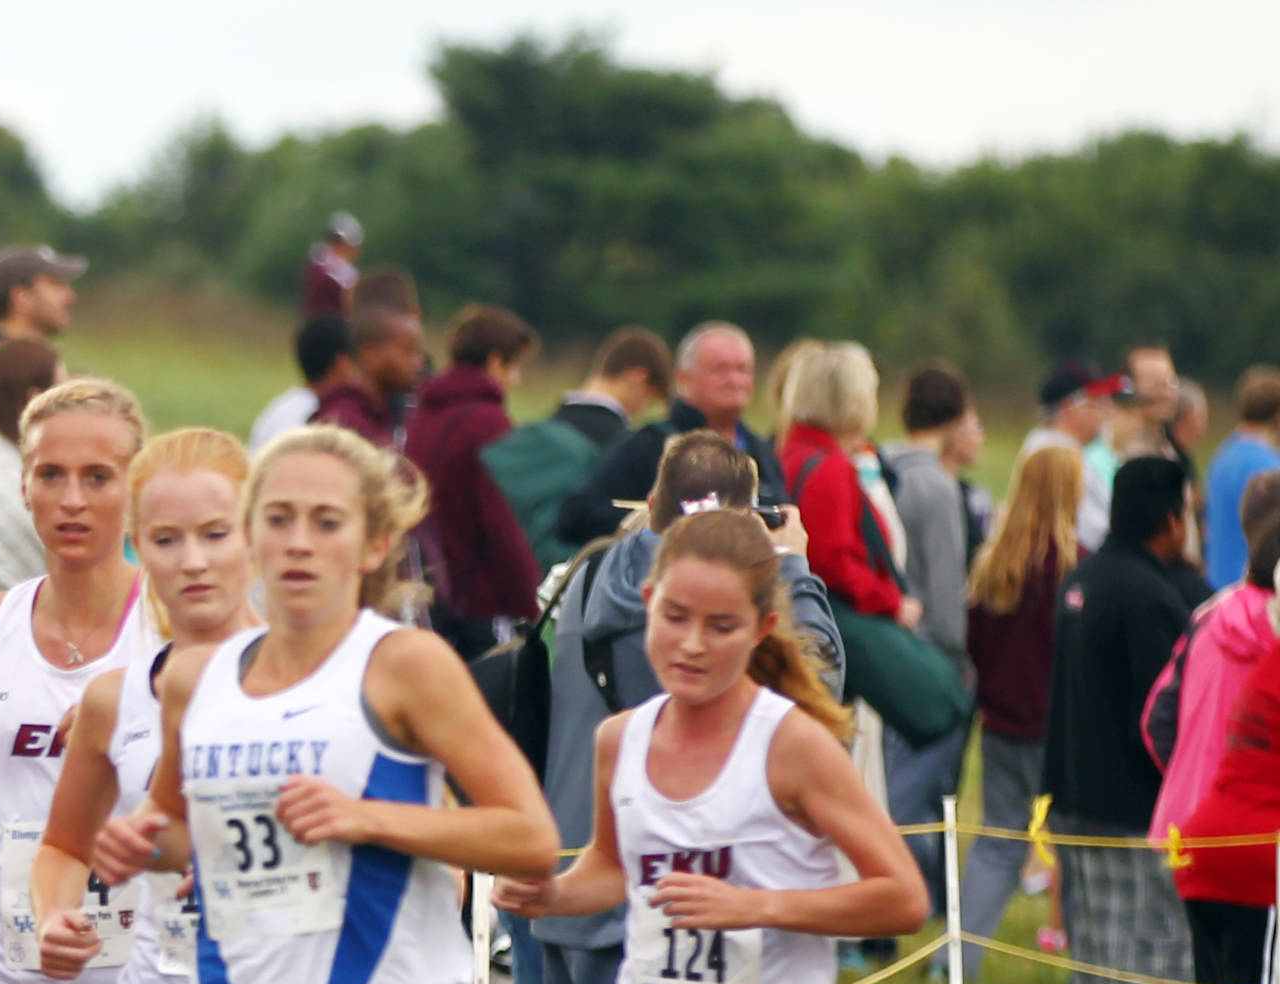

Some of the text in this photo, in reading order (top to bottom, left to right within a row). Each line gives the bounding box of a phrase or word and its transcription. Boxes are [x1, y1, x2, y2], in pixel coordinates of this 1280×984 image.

[184, 740, 328, 778] ENTUCKY
[226, 815, 281, 872] 33
[639, 846, 733, 885] EKU
[661, 928, 727, 984] 124
